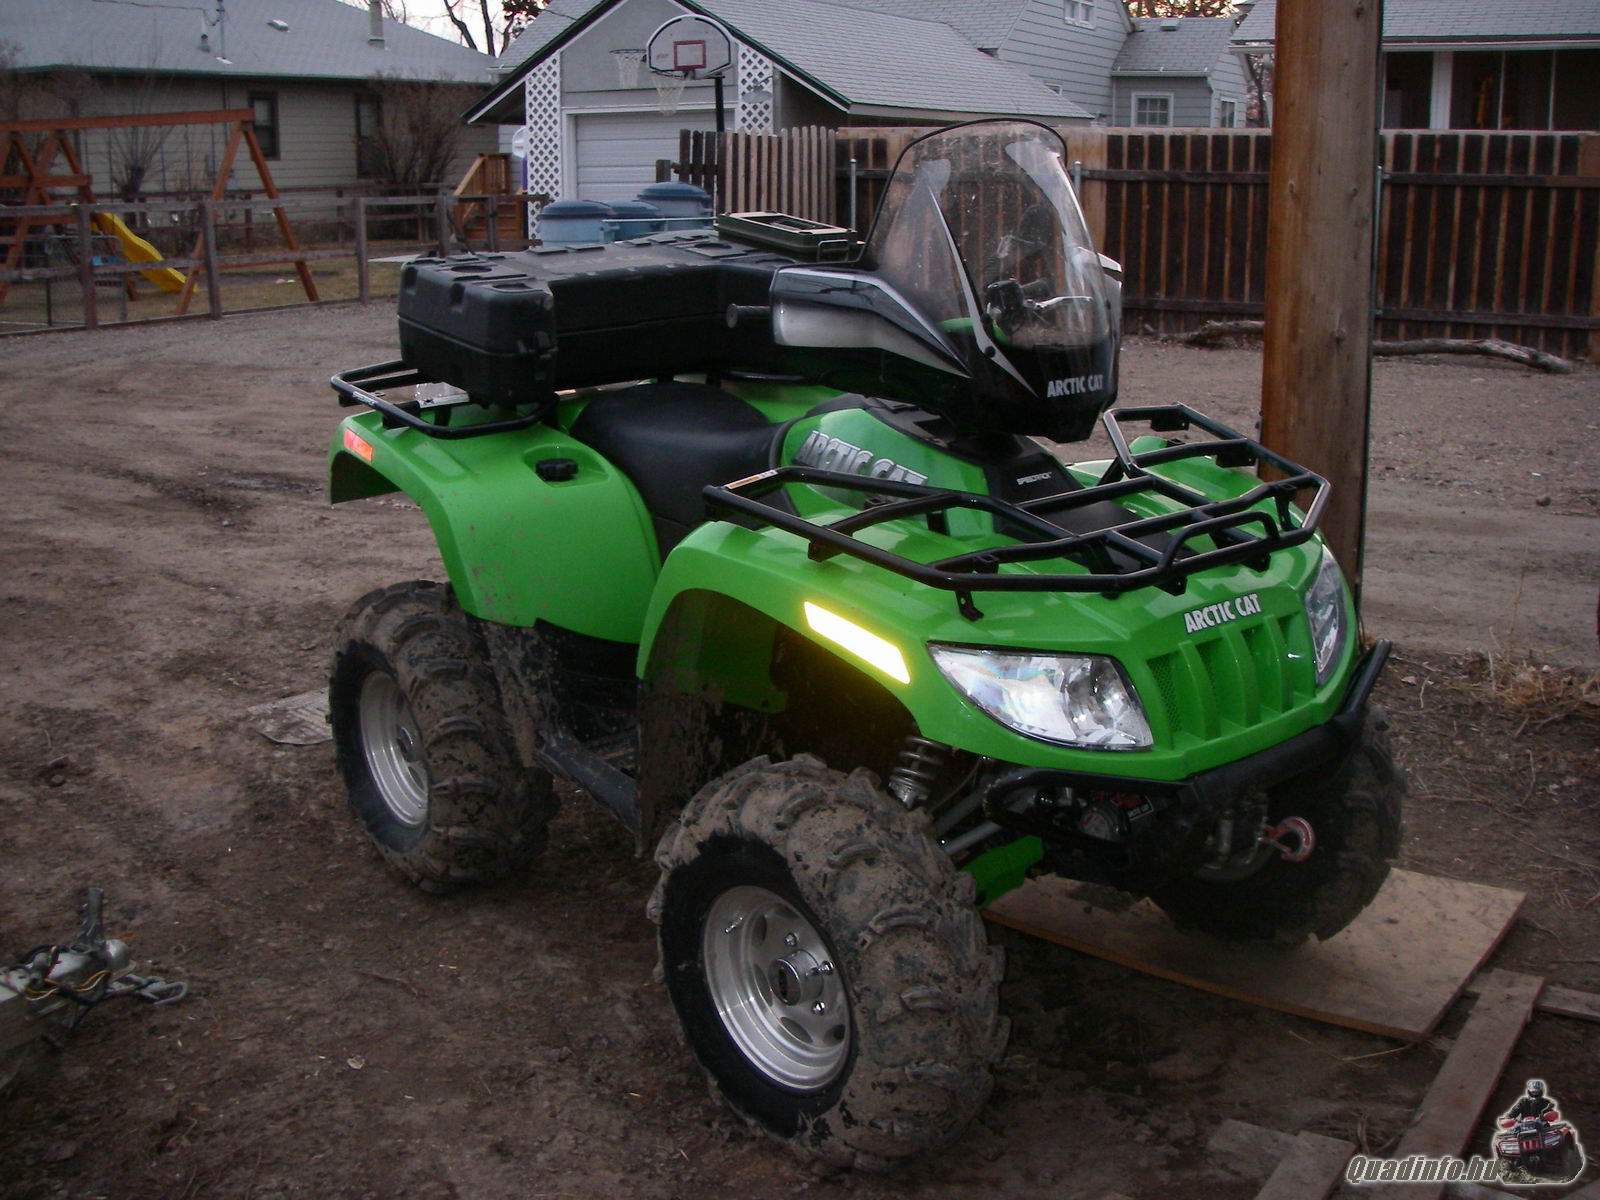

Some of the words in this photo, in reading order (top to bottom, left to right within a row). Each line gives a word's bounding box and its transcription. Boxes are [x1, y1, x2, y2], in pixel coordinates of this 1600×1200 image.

[1047, 377, 1086, 397] ARCTIC
[1087, 374, 1103, 392] CAT
[793, 431, 873, 474] ARCTIC
[1184, 601, 1236, 633] ARCTIC
[1235, 593, 1261, 616] CAT
